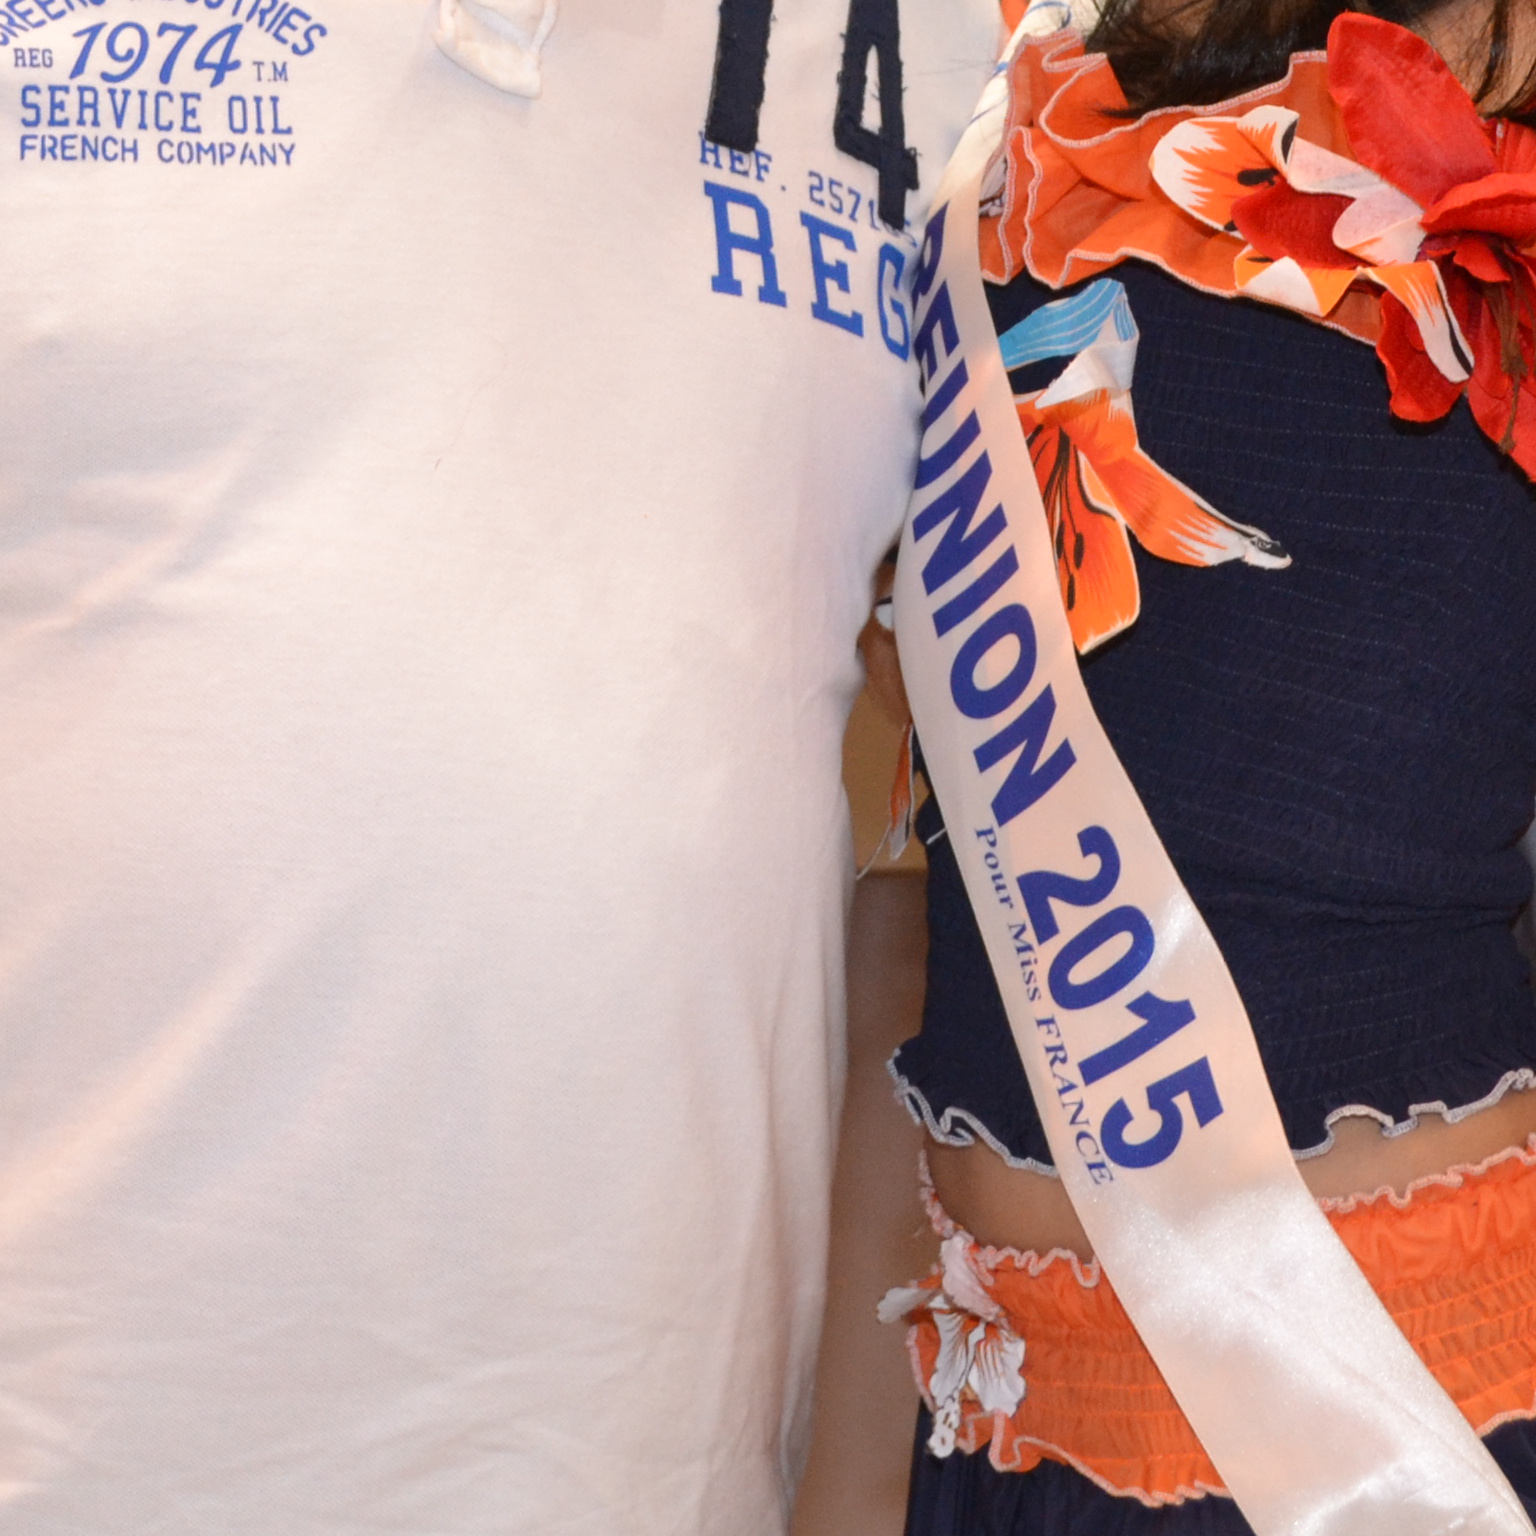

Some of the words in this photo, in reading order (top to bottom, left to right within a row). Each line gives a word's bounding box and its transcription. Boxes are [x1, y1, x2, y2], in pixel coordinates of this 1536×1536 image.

[14, 47, 54, 69] REG
[68, 21, 244, 88] 1974
[20, 84, 202, 134] SERVICE
[227, 95, 293, 135] OIL
[20, 134, 139, 163] FRENCH
[157, 138, 296, 166] COMPANY
[703, 180, 911, 363] REG
[974, 825, 1014, 910] Pour
[1008, 921, 1042, 1003] Miss
[1035, 1014, 1115, 1186] FRANCE
[1016, 824, 1224, 1170] 2015
